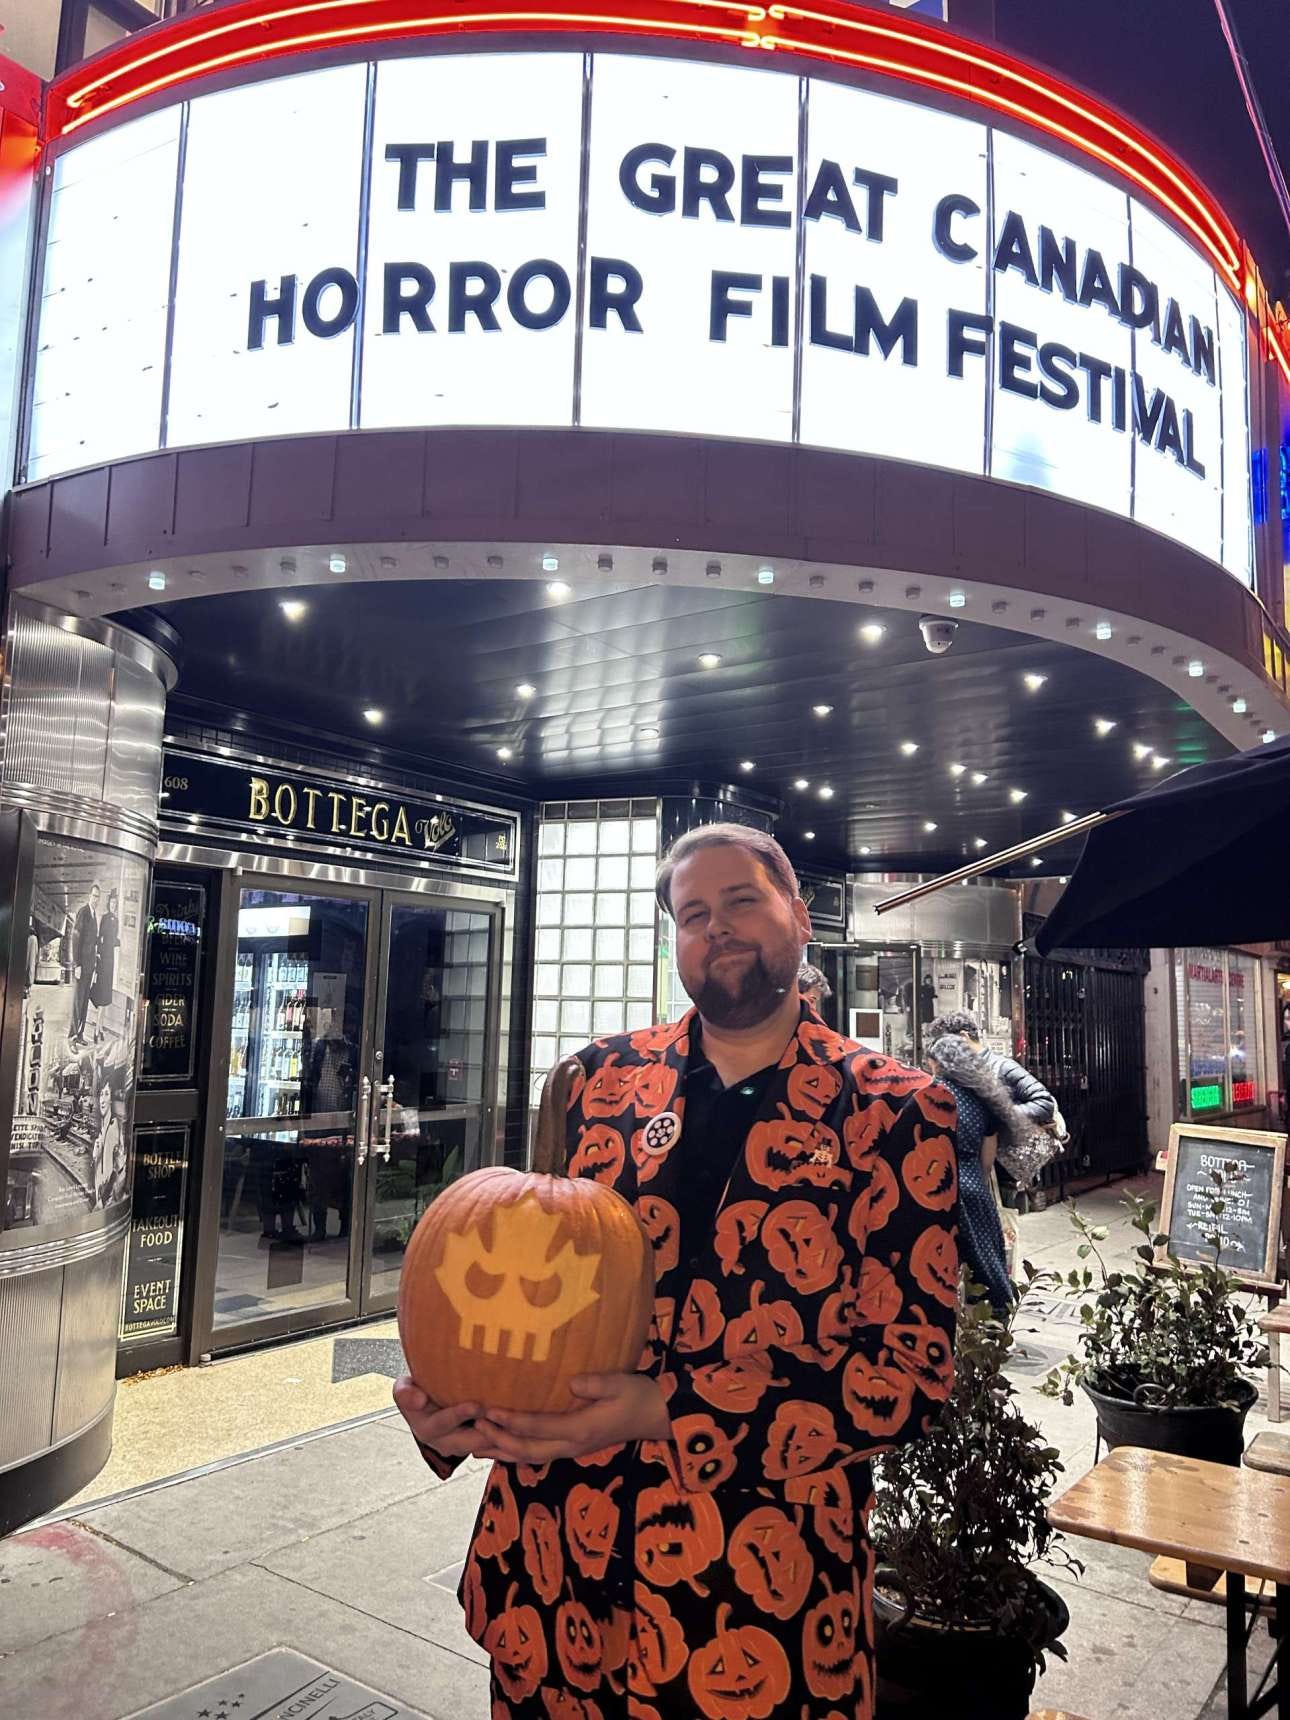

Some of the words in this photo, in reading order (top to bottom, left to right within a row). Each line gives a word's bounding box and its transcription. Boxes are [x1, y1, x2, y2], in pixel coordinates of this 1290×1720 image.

[384, 137, 547, 213] THE
[619, 142, 898, 244] GREAT
[933, 193, 1215, 386] CANADIAN
[247, 255, 644, 351] HORROR
[708, 269, 918, 367] FILM
[946, 308, 1205, 480] FESTIVAL
[164, 775, 189, 791] 608
[249, 776, 412, 847] BOTTEGA
[160, 951, 188, 966] WINE
[152, 973, 192, 987] SPIRITS
[154, 993, 185, 1007] CIDER
[153, 1013, 184, 1027] SODA
[149, 1035, 187, 1049] COFFEE
[143, 1150, 183, 1166] BOTTLE
[1200, 1154, 1248, 1172] BOTTA
[147, 1164, 175, 1180] SHOP
[132, 1214, 179, 1232] TAKEOUT
[140, 1231, 173, 1248] FOOD
[133, 1279, 171, 1299] EVENT
[133, 1295, 167, 1314] SPACE
